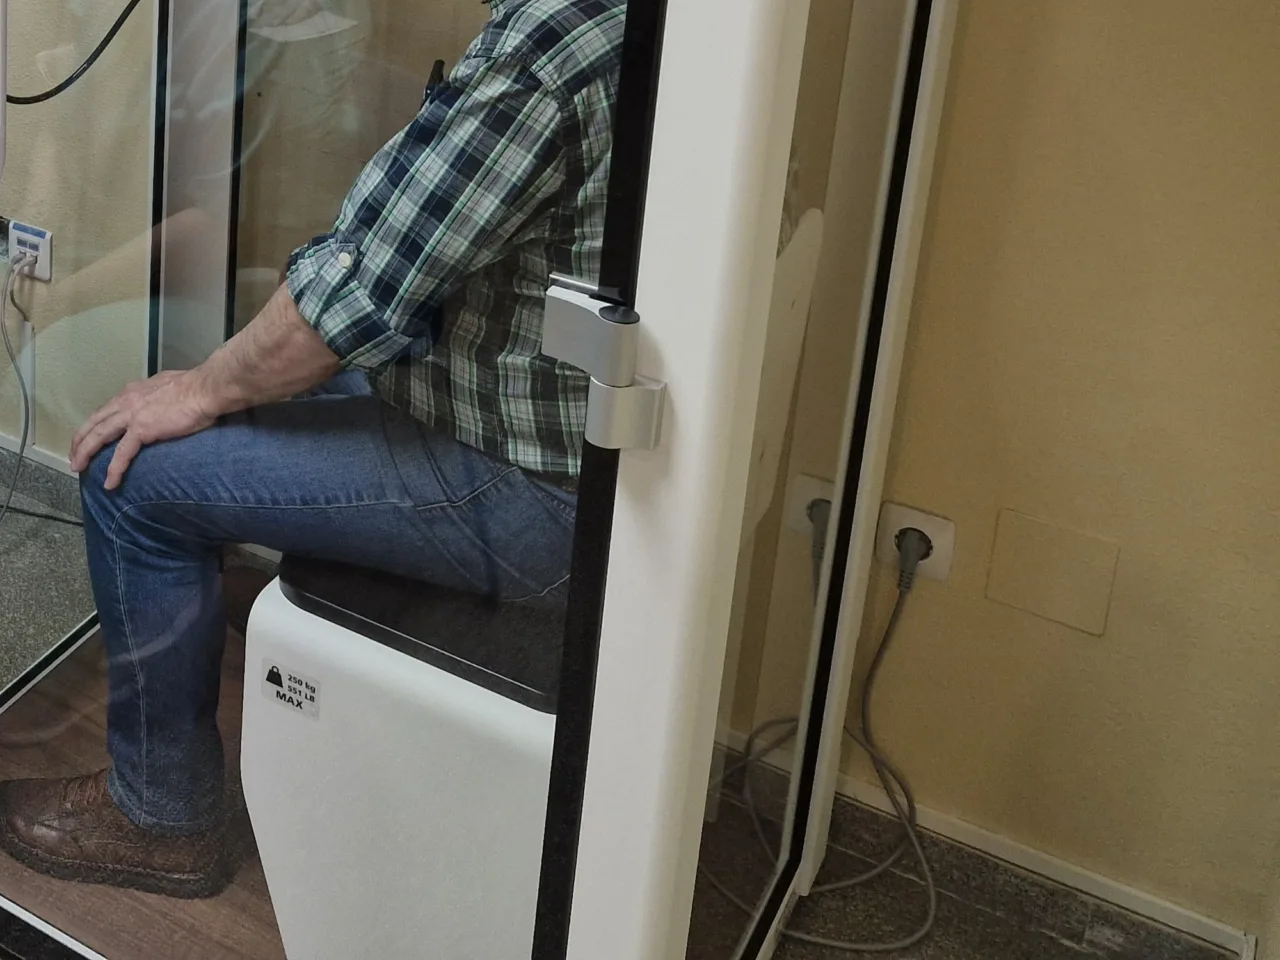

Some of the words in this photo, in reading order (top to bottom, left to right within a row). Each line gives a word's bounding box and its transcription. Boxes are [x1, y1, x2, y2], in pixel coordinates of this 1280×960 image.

[288, 674, 303, 686] 250
[305, 682, 316, 694] kg
[276, 689, 303, 710] MAX
[305, 693, 315, 703] LB
